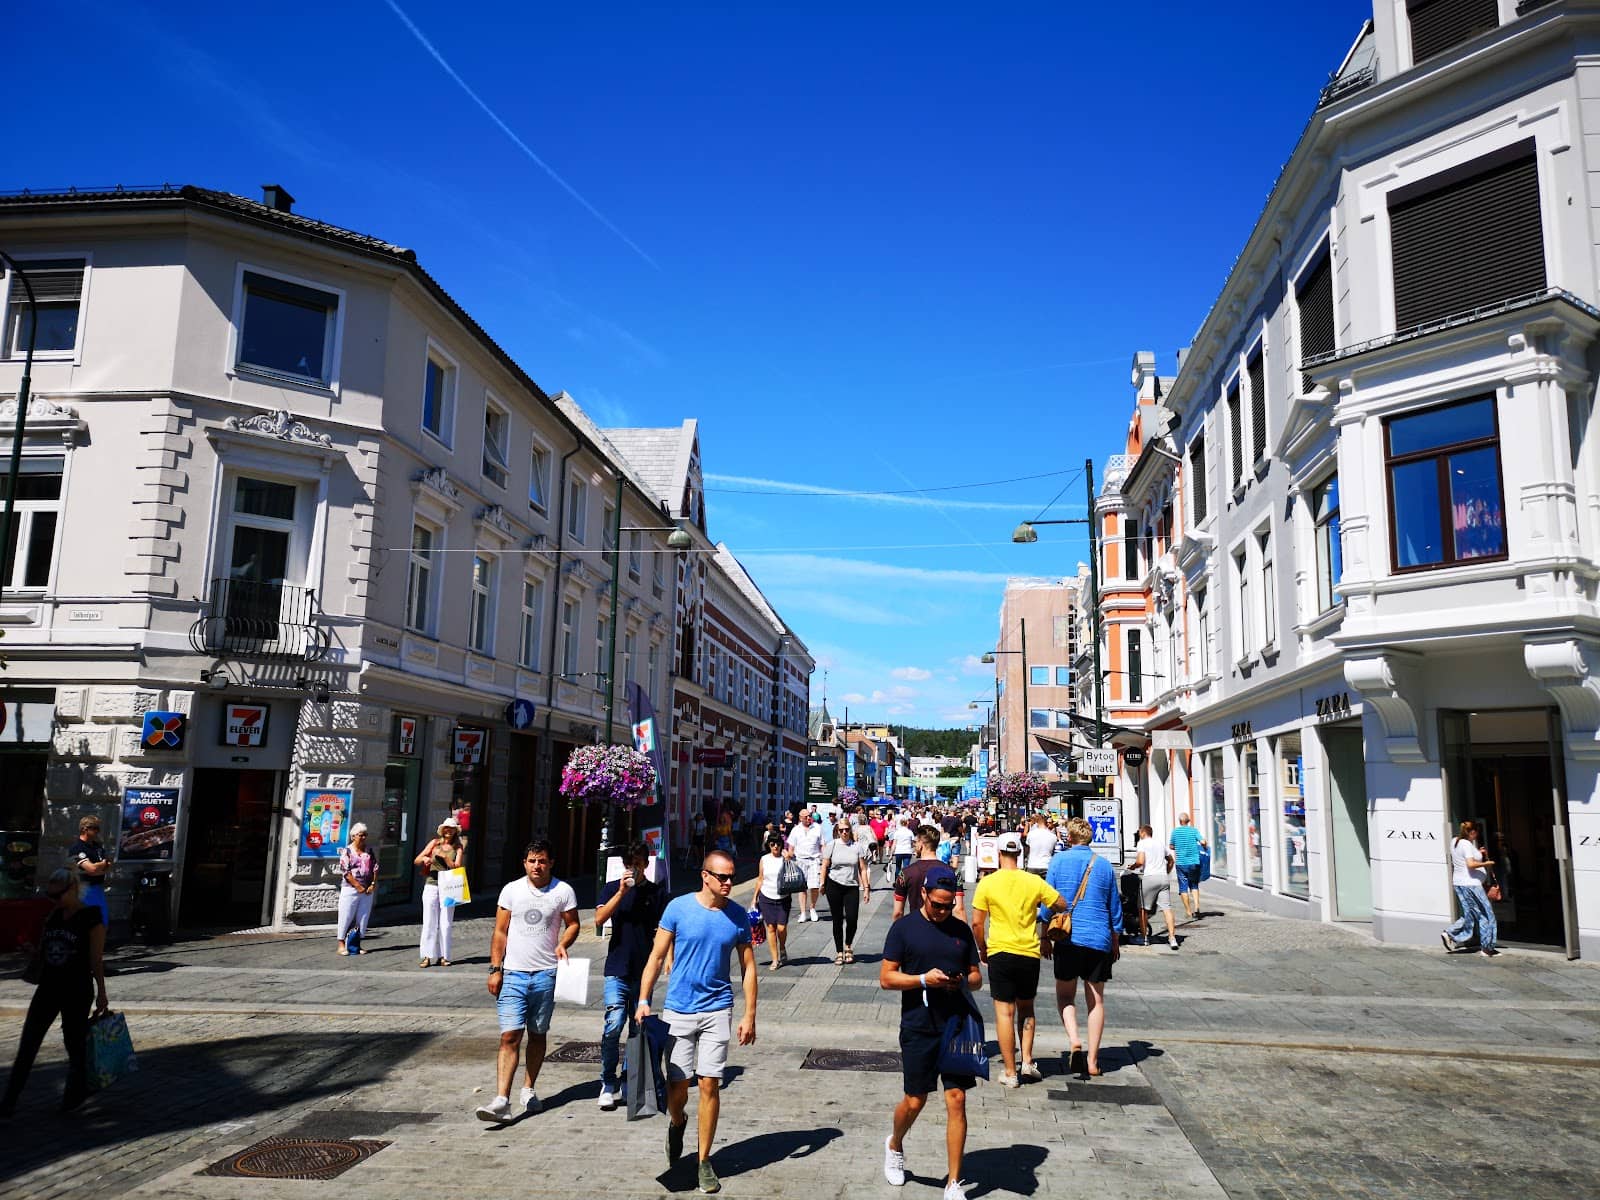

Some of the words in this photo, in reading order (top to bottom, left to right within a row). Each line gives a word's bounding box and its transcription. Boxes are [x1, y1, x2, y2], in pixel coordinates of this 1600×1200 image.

[1316, 692, 1351, 716] ZARA
[1231, 720, 1252, 738] ZARA
[1086, 751, 1115, 762] Bytog
[1089, 764, 1113, 773] tillatt
[140, 791, 166, 799] TACO-
[1387, 829, 1437, 840] ZARA
